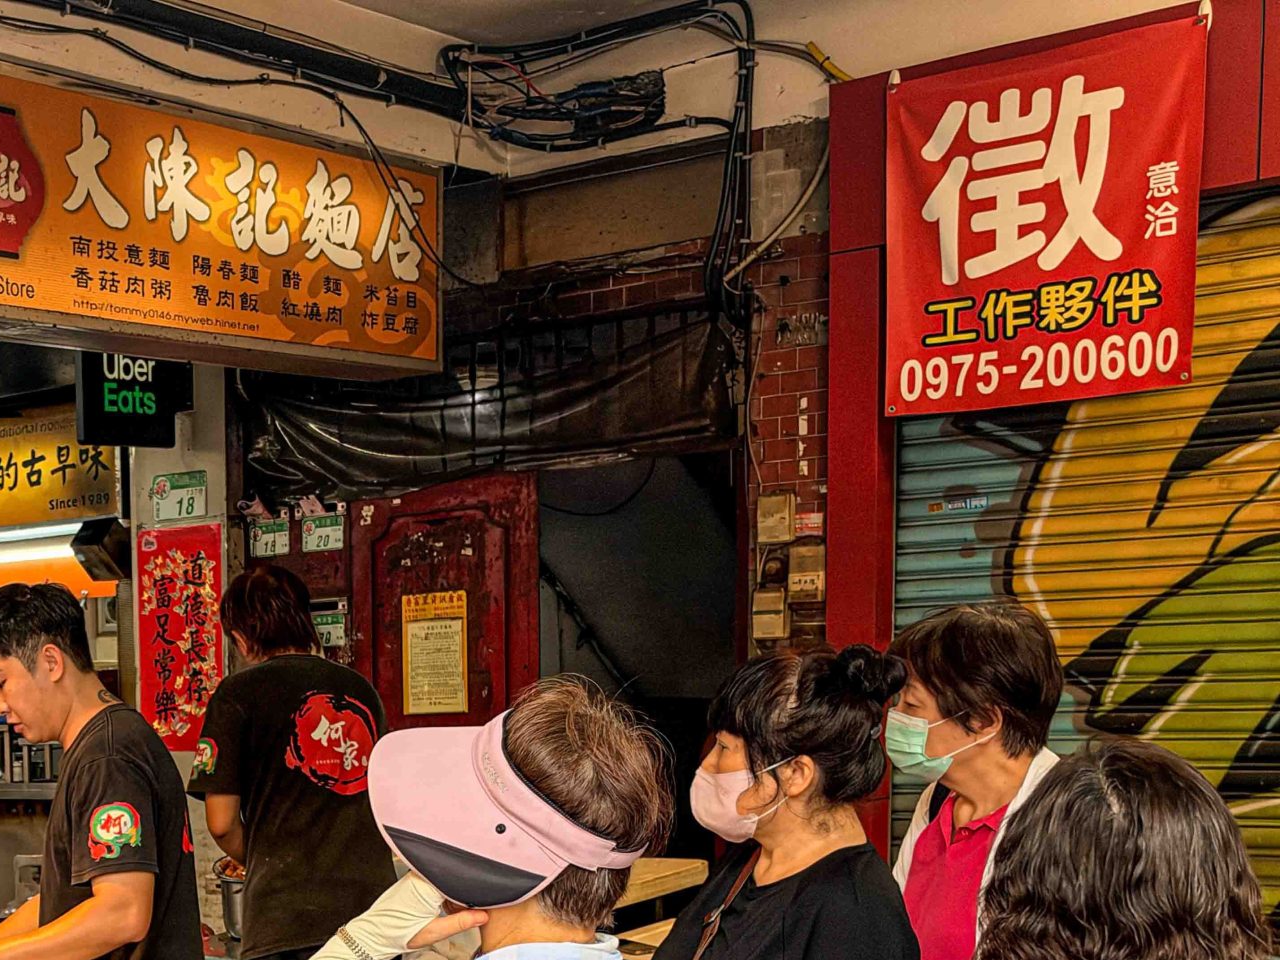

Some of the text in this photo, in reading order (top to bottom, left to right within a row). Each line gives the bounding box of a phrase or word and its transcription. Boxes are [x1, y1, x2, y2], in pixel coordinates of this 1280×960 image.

[62, 108, 425, 282] 大陳記麵店
[921, 75, 1125, 286] 徵
[1144, 161, 1180, 240] 意洽
[70, 236, 170, 270] 南投意麵
[192, 255, 260, 285] 陽春麵
[363, 284, 418, 310] 米苔目
[71, 267, 420, 336] 香菇肉粥 魯肉飯 紅燒肉 炸豆腐
[923, 272, 1161, 346] 工作夥伴
[103, 353, 156, 382] Uber
[104, 383, 157, 415] Eats
[900, 327, 1180, 402] 0975-200600
[48, 493, 110, 511] Since 1989
[176, 496, 195, 516] 18
[316, 534, 330, 548] 20
[152, 574, 177, 722] 富足常樂
[311, 715, 359, 770] 何家
